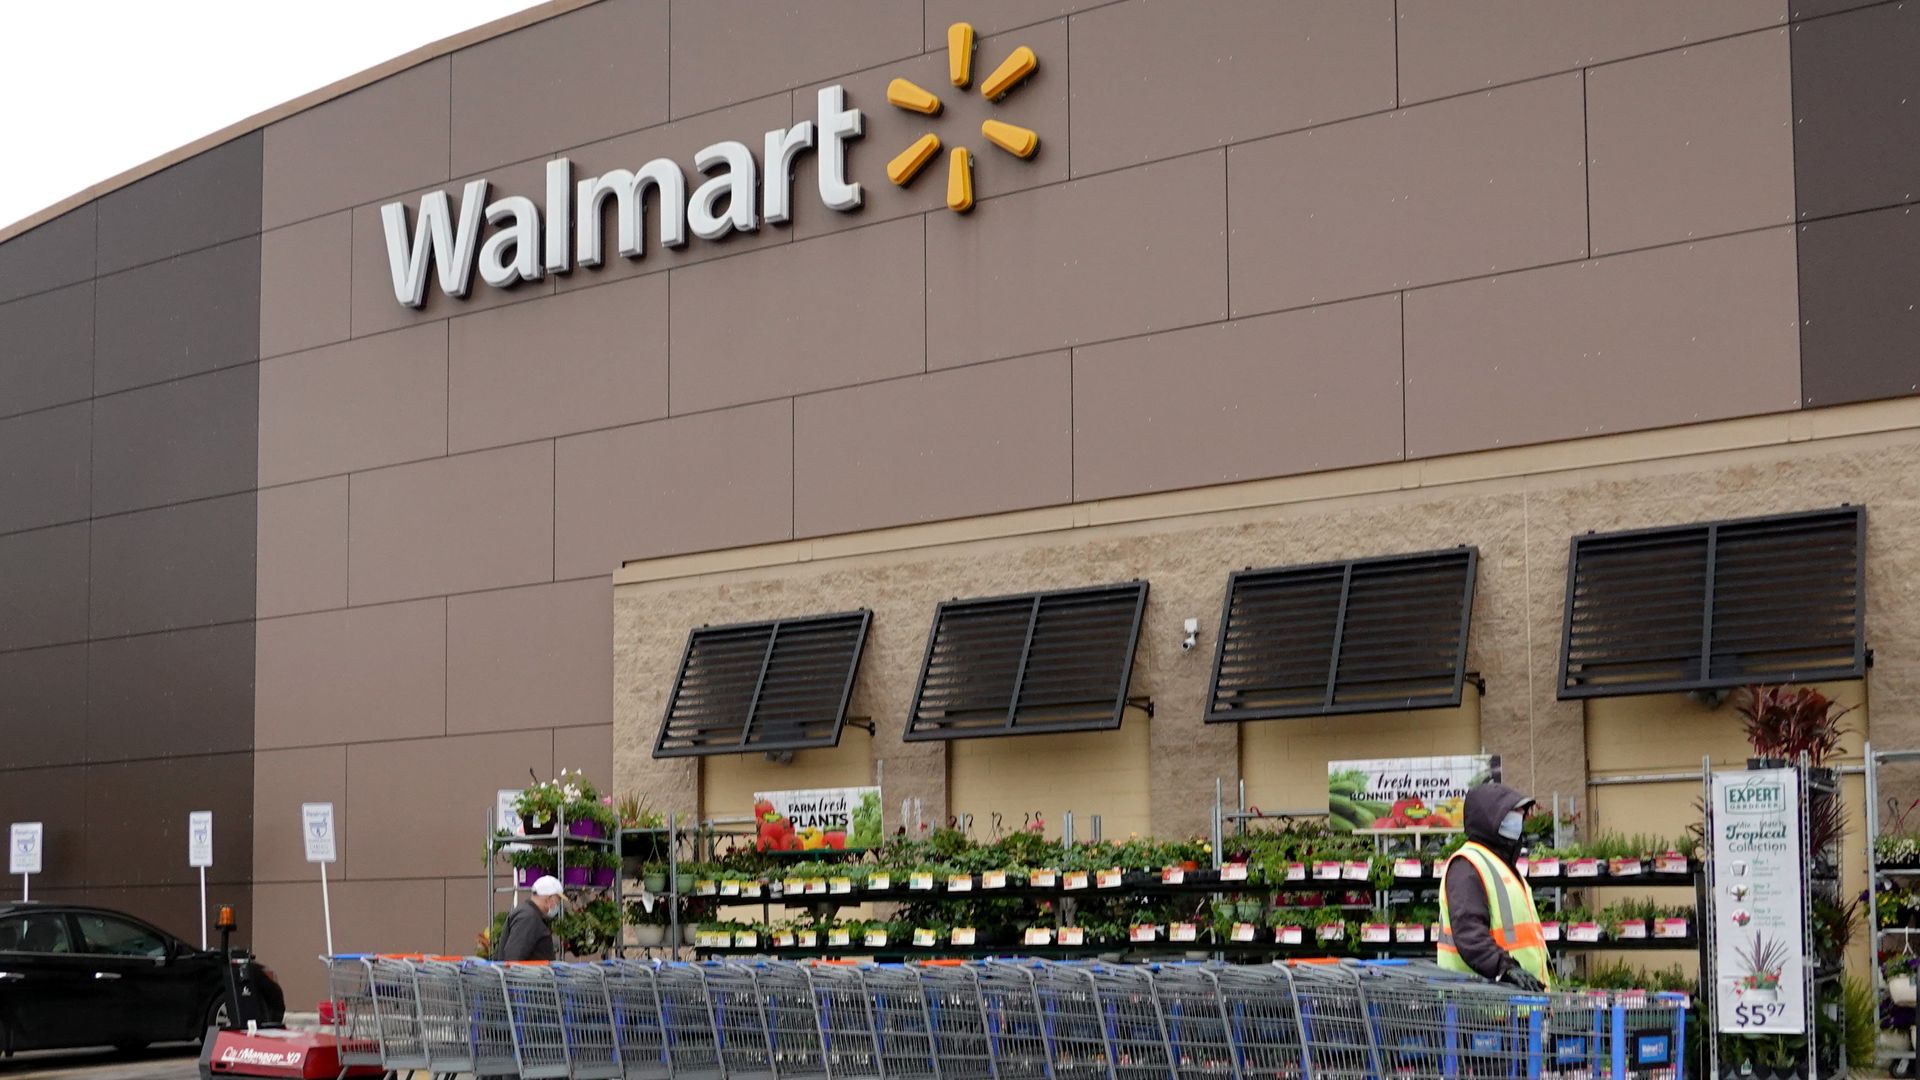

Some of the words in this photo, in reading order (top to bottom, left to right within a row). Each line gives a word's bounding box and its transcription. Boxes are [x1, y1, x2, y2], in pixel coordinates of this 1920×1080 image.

[380, 84, 863, 308] Walmart
[1377, 773, 1411, 788] fresh
[1415, 778, 1450, 787] FROM
[1349, 790, 1393, 801] BONNIE
[1397, 789, 1435, 799] PLANT
[1729, 787, 1780, 803] EXPERT
[788, 803, 816, 813] FARM
[818, 797, 846, 812] fresh
[789, 813, 849, 828] PLANTS
[1726, 823, 1787, 844] Tropical
[1728, 842, 1787, 854] Collection
